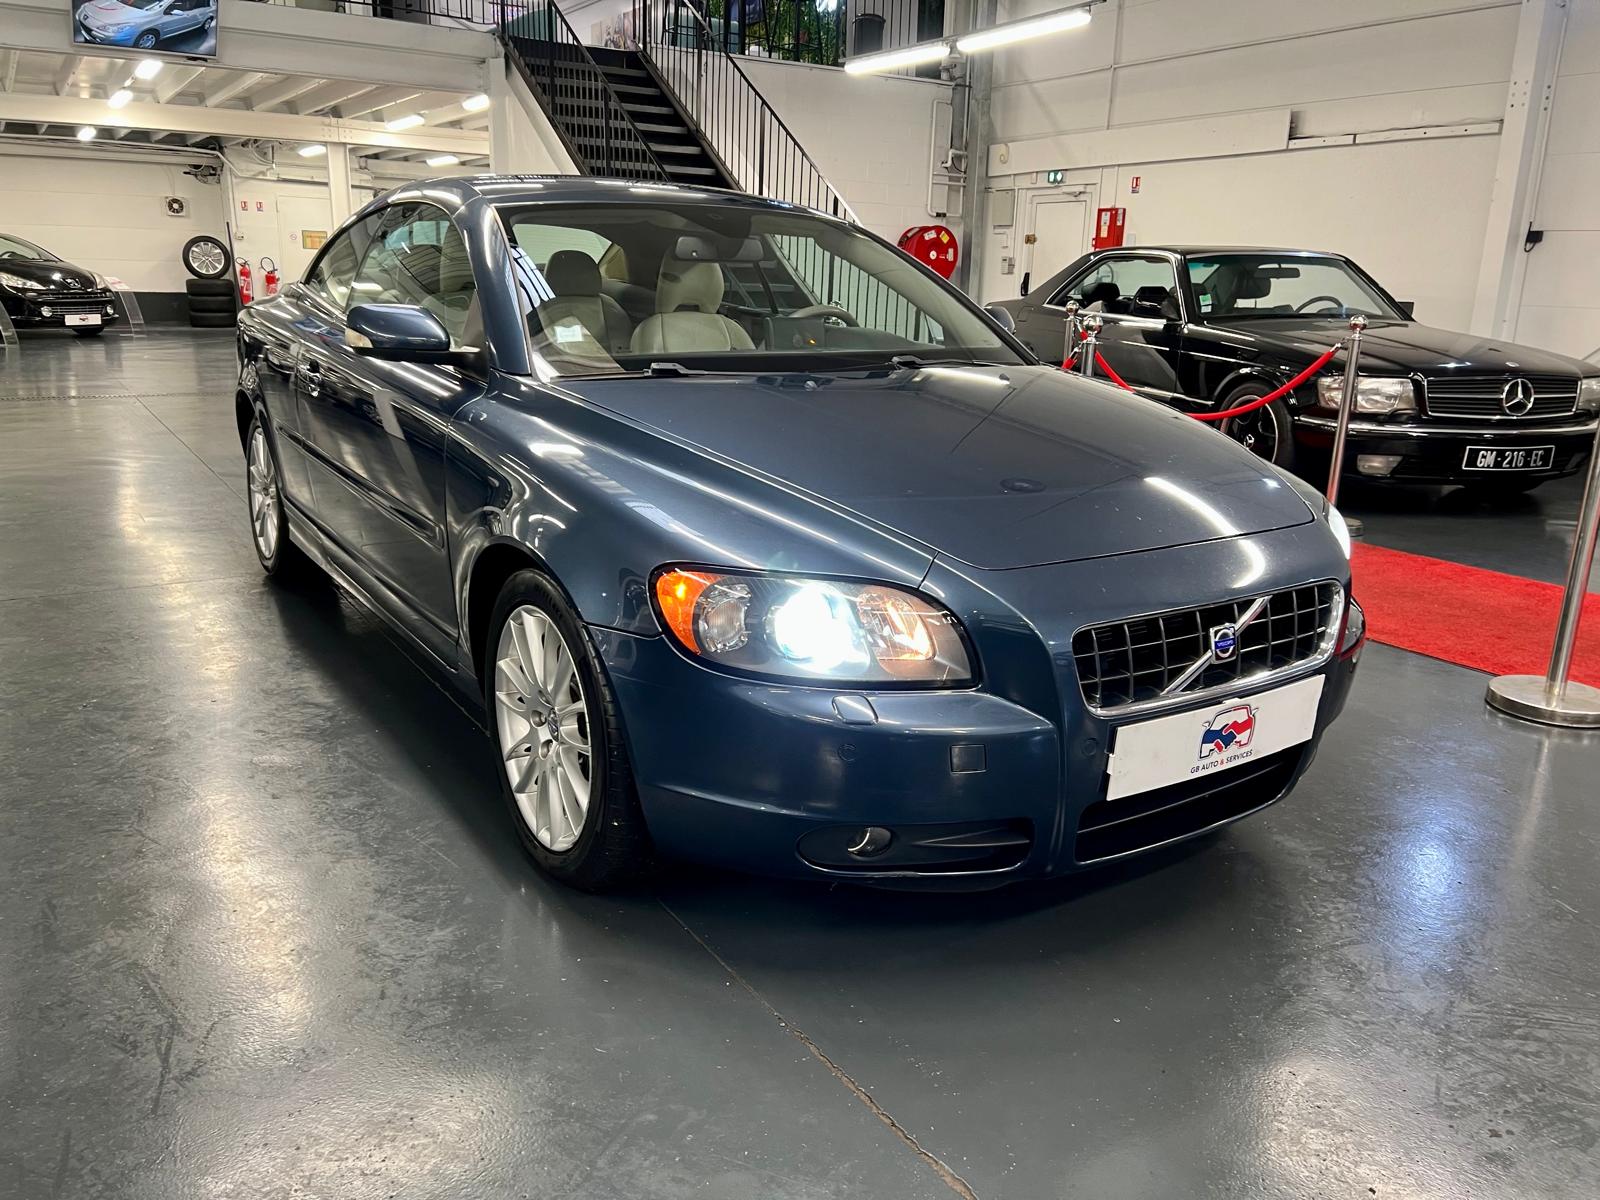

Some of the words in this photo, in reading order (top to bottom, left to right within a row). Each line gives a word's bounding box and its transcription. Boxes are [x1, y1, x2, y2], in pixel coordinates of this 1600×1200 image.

[1190, 766, 1200, 774] GB
[1200, 760, 1219, 771] AUTO
[1219, 758, 1225, 766] &
[1225, 749, 1253, 764] SERVICES
